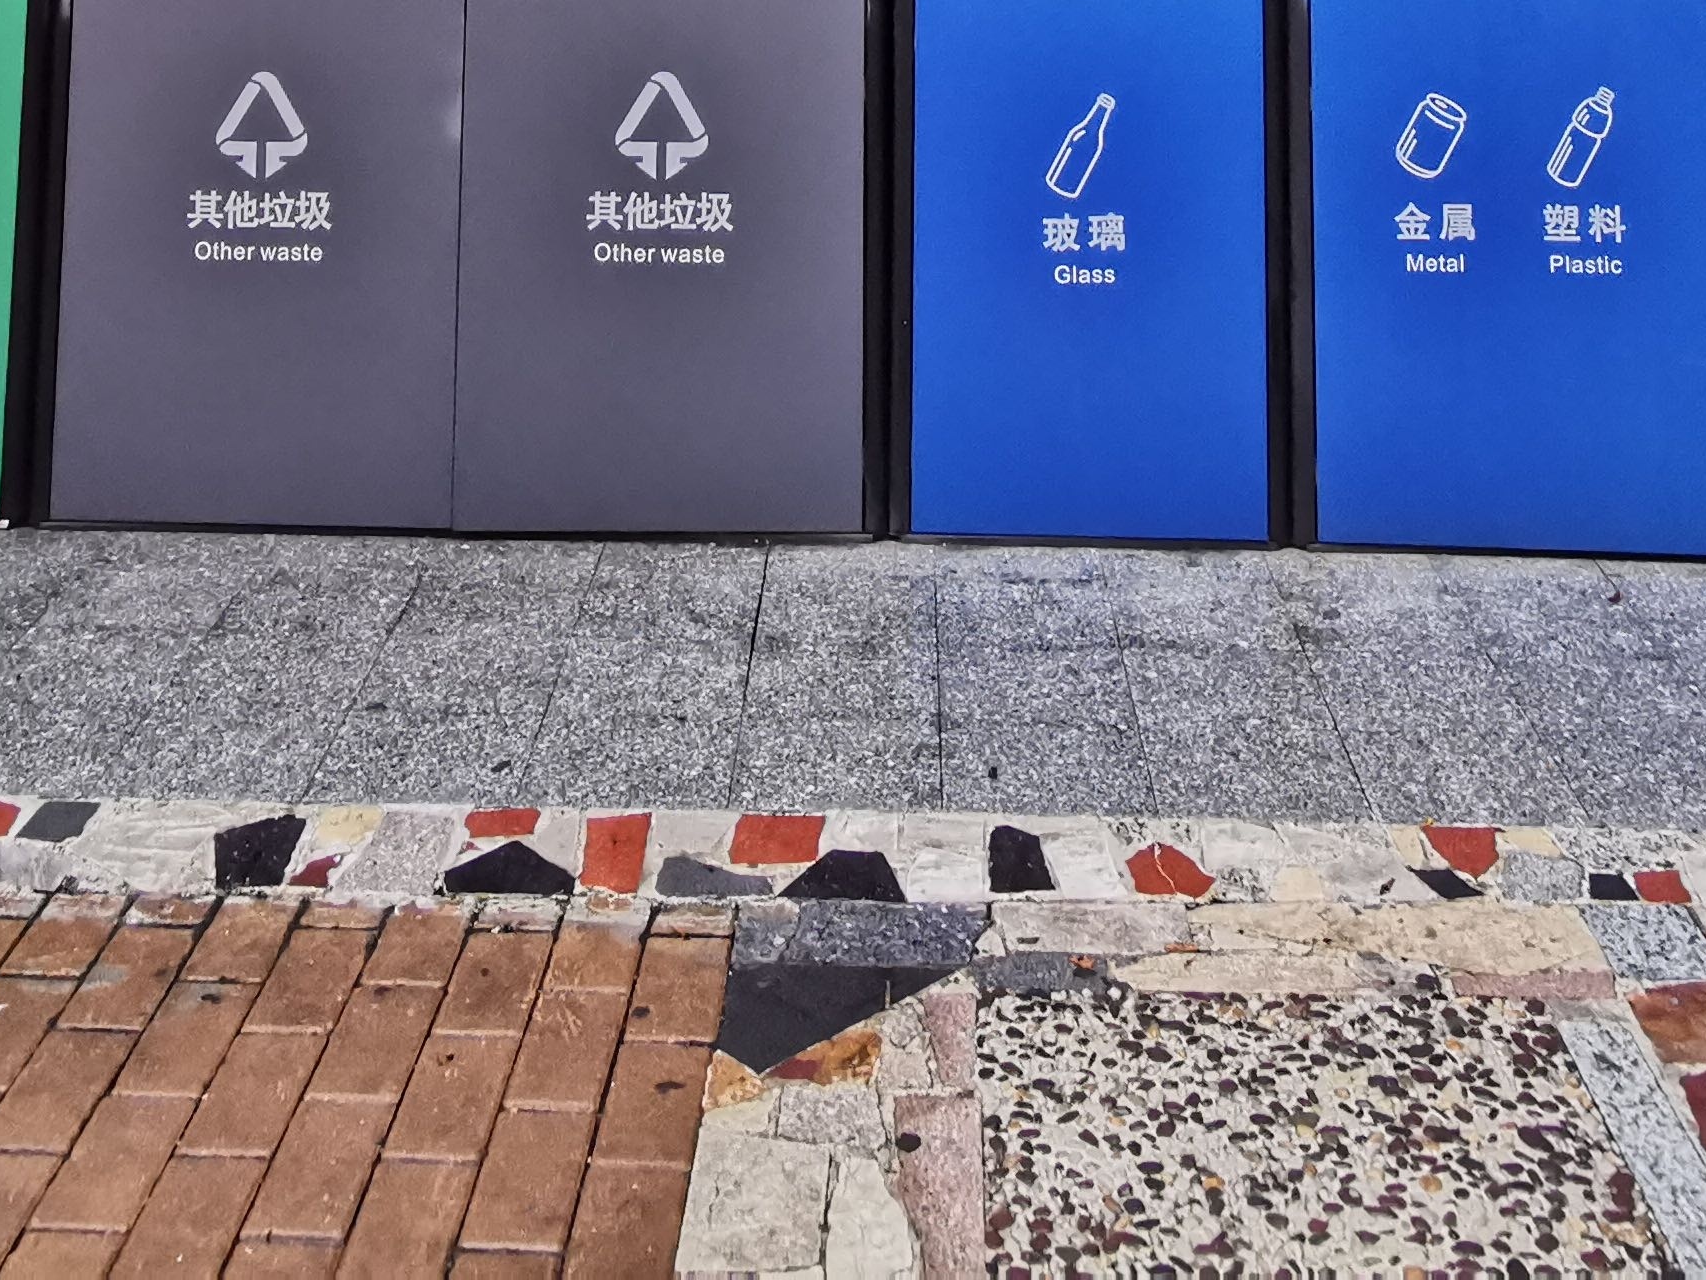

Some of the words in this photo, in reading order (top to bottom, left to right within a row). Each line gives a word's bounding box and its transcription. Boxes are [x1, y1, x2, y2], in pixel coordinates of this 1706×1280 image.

[186, 190, 333, 231] 其他垃圾
[586, 191, 734, 232] 其他垃圾
[1394, 202, 1476, 241] 金属
[1543, 203, 1627, 243] 塑料
[1042, 212, 1126, 252] 玻璃
[194, 241, 256, 261] Other
[260, 243, 324, 262] waste
[594, 242, 656, 263] Other
[660, 244, 725, 264] waste
[1406, 253, 1465, 273] Metal
[1549, 254, 1623, 274] Plastic
[1054, 265, 1116, 284] Glass
